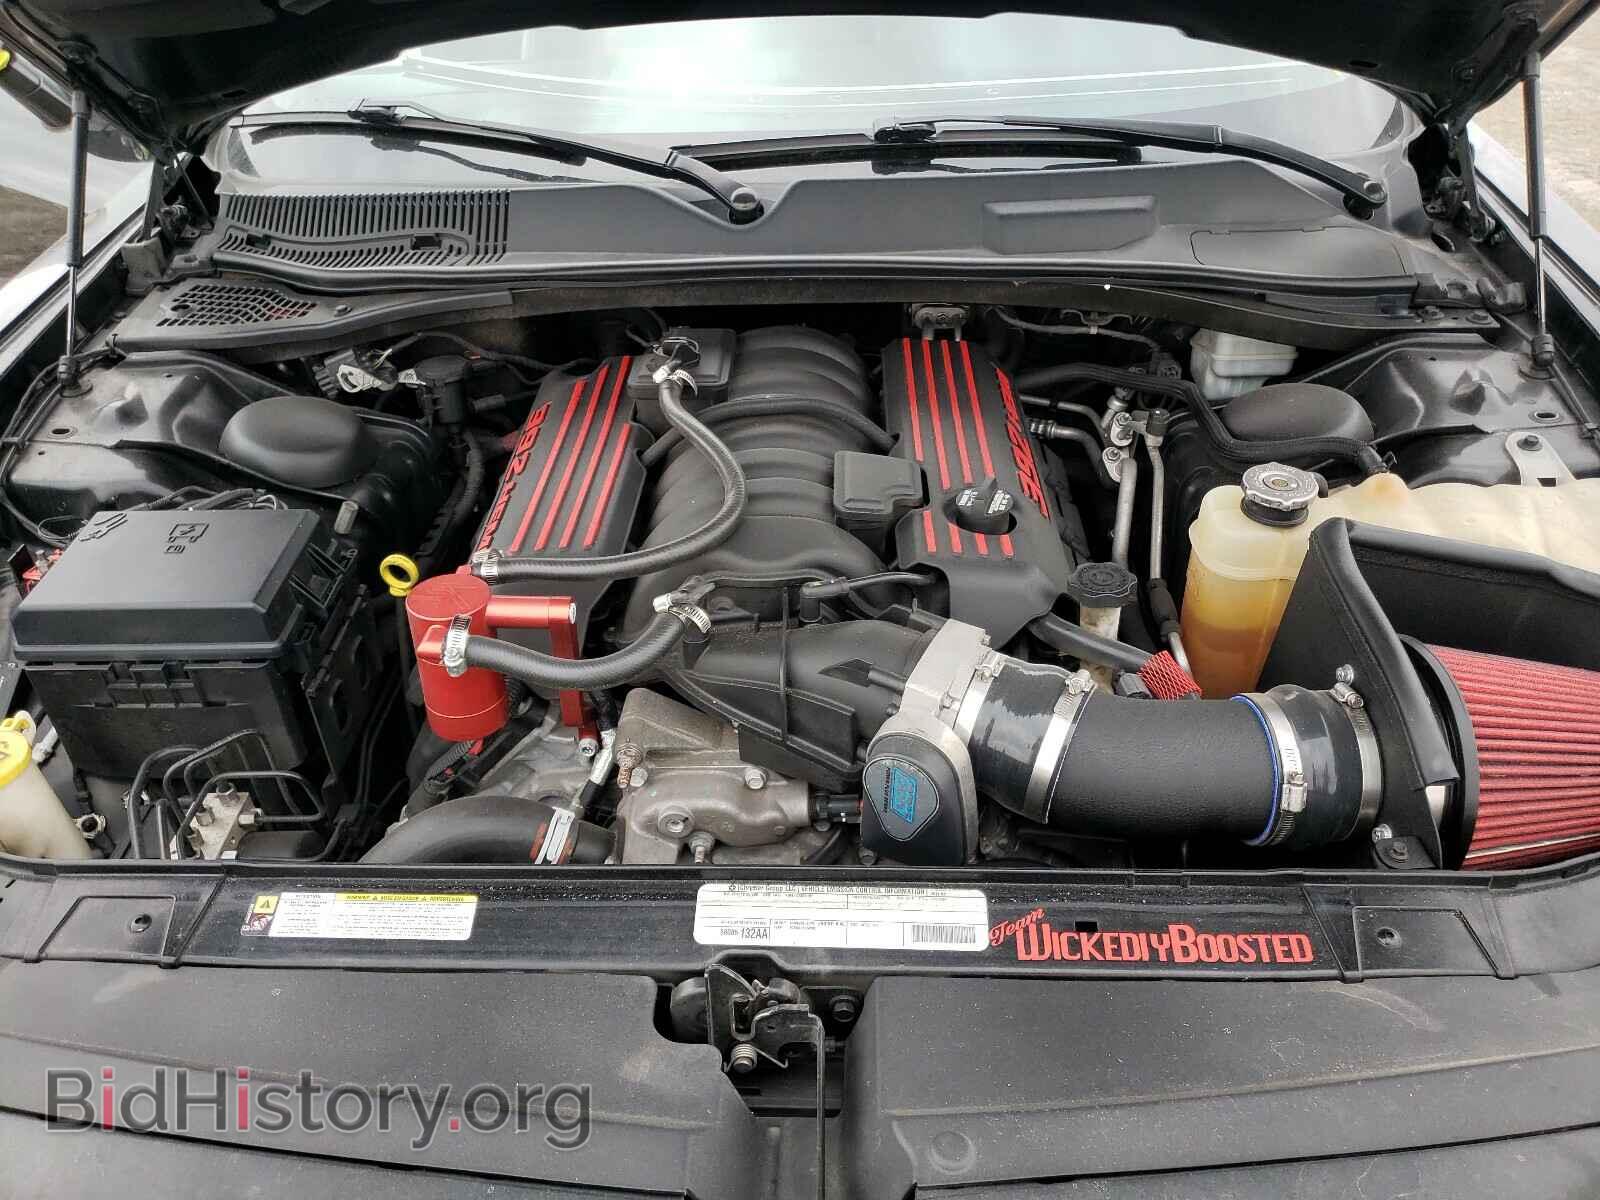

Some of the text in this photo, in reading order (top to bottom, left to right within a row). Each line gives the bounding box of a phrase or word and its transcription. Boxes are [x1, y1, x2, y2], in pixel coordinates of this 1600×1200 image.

[477, 401, 551, 551] 392 HEM
[741, 927, 767, 940] 132AA
[990, 907, 1046, 946] Team
